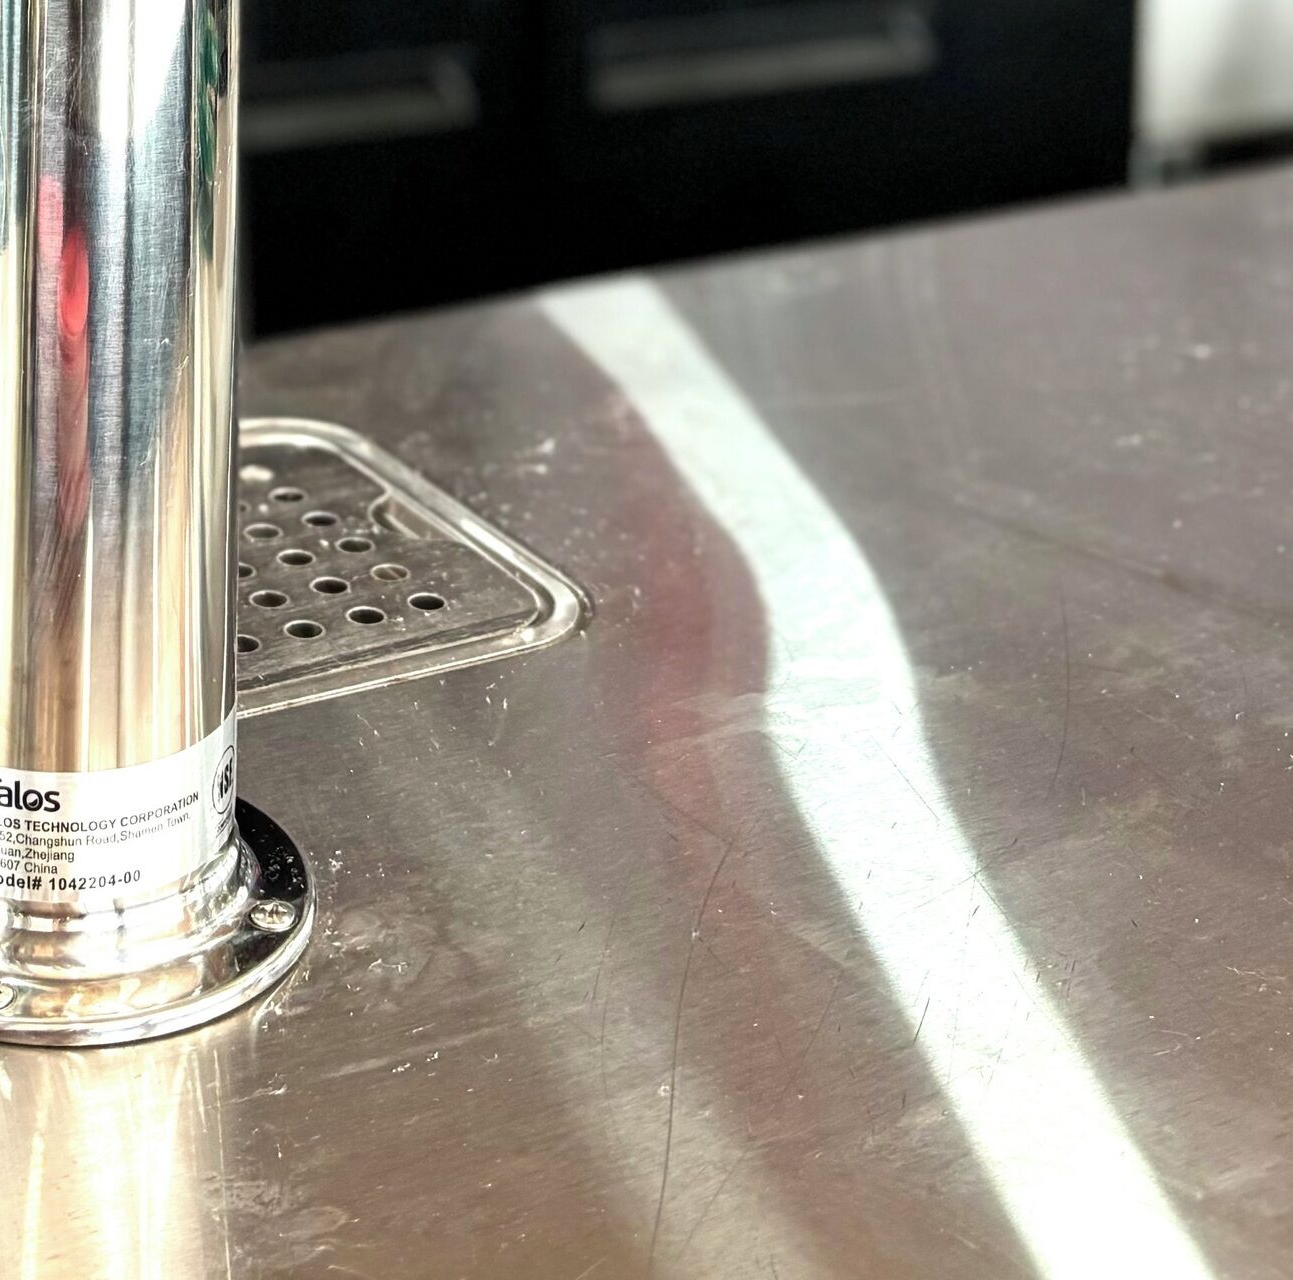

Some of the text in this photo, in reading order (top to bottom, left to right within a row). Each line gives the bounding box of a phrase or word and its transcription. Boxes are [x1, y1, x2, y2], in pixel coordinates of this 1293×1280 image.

[24, 819, 117, 833] TECHNOLOGY
[120, 791, 199, 827] CORPORATION
[24, 861, 58, 874] China
[48, 870, 141, 891] 1042204-00
